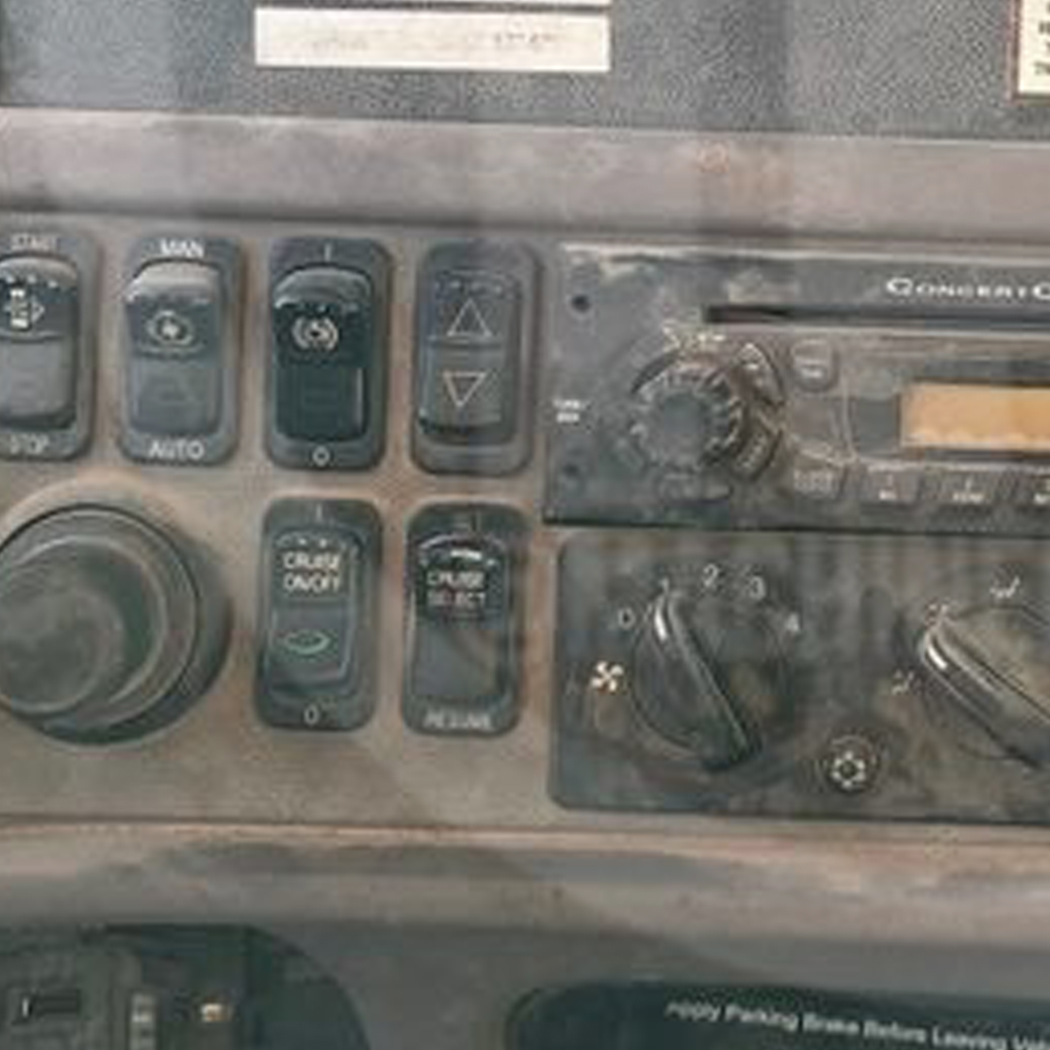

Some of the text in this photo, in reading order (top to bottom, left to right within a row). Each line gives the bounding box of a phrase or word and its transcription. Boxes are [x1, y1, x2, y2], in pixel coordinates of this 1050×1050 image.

[160, 237, 204, 257] MAN
[149, 439, 205, 460] AUTO
[283, 552, 341, 570] CRUISE
[283, 572, 341, 593] ON/OFF
[724, 1004, 798, 1032] Parking
[802, 1012, 860, 1034] Brake
[863, 1019, 927, 1044] Before
